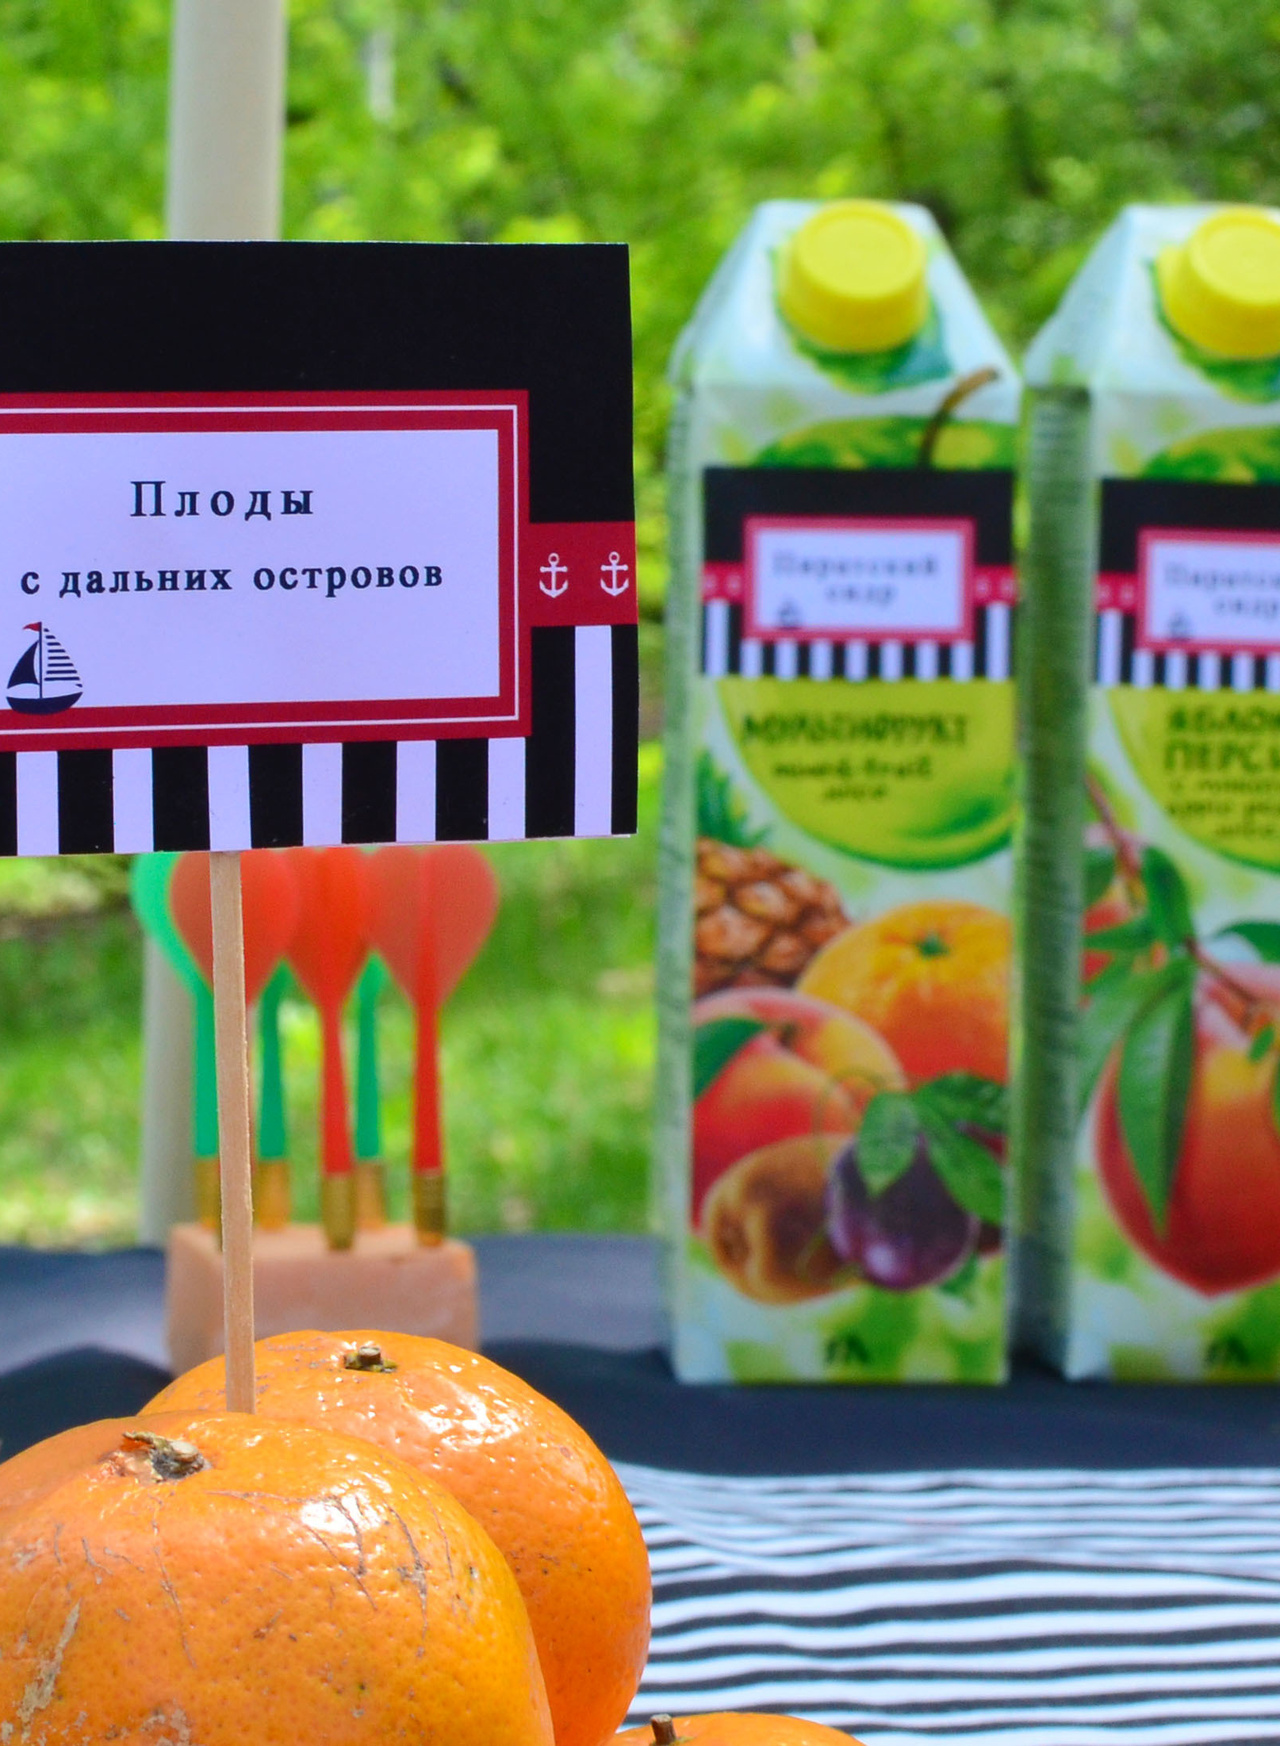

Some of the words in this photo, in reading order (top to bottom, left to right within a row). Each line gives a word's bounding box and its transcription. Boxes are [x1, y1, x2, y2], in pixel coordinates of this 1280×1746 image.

[129, 480, 314, 523] Плоды
[20, 571, 40, 595] с
[59, 569, 234, 599] дальних
[253, 566, 443, 598] островов
